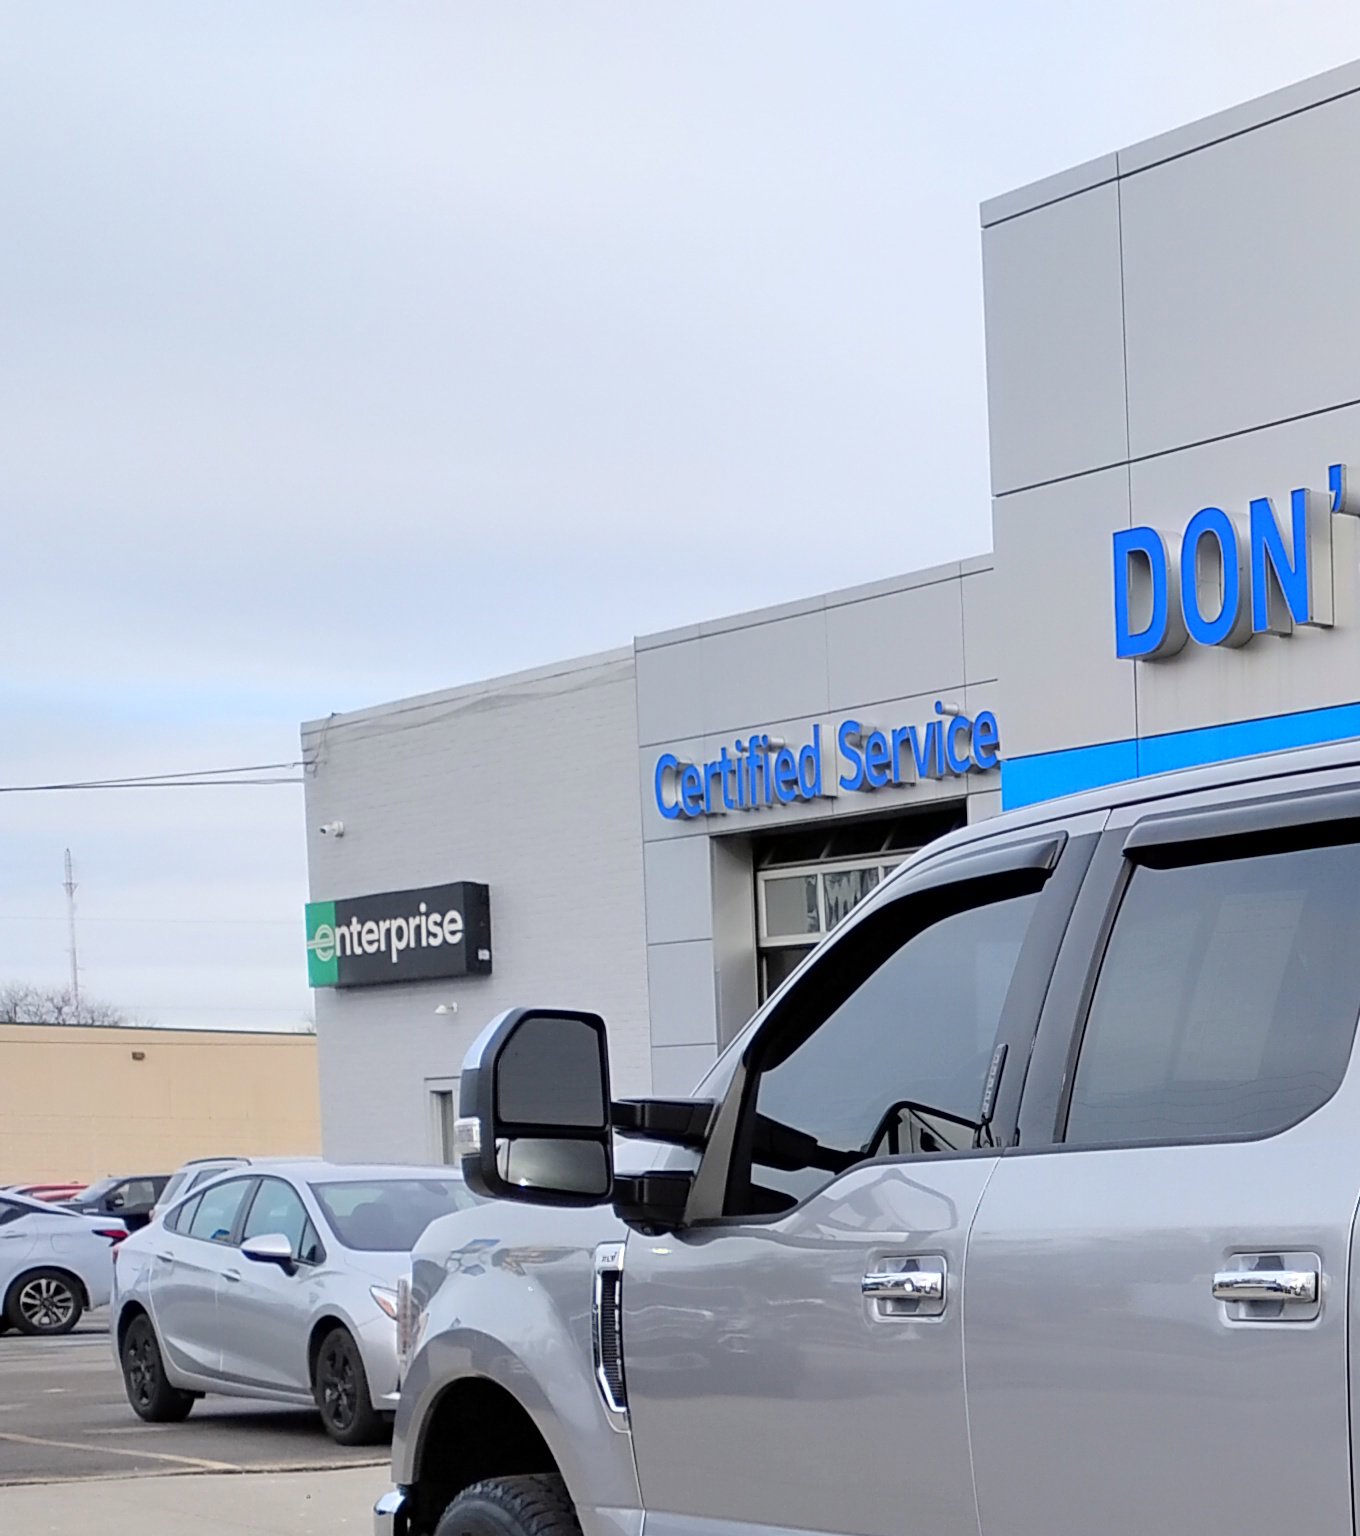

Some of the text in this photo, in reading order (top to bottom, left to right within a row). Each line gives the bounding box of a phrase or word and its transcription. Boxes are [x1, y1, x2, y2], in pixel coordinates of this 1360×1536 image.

[654, 700, 1001, 821] Certified Service
[307, 902, 463, 963] enterprise
